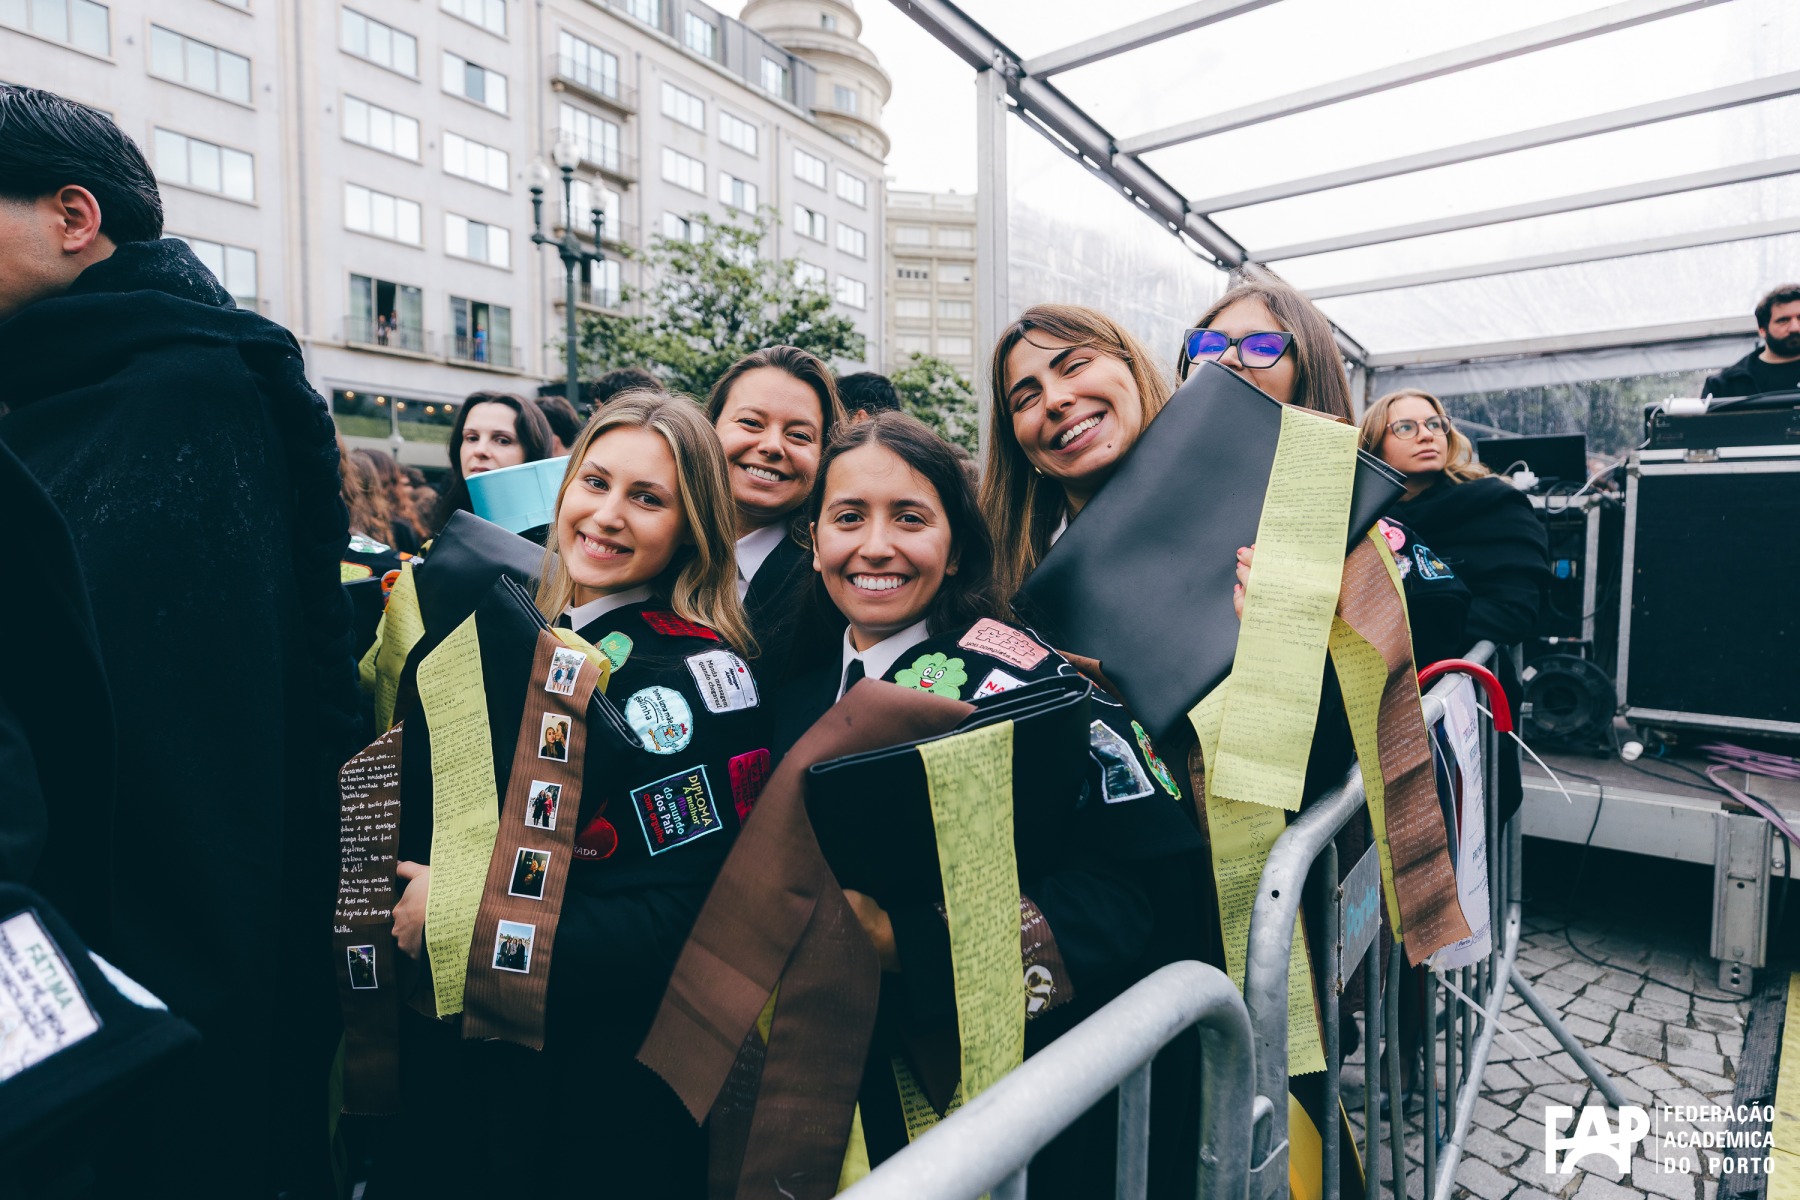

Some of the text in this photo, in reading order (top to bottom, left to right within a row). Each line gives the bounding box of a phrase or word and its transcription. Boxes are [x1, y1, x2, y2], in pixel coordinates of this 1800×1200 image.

[965, 641, 977, 649] you
[979, 643, 1010, 659] complete
[714, 678, 728, 707] mensagem
[654, 794, 666, 812] dos
[663, 787, 685, 835] do mundo
[686, 795, 701, 825] melhor
[688, 775, 713, 827] DIPLOMA
[643, 793, 665, 844] com orgulho
